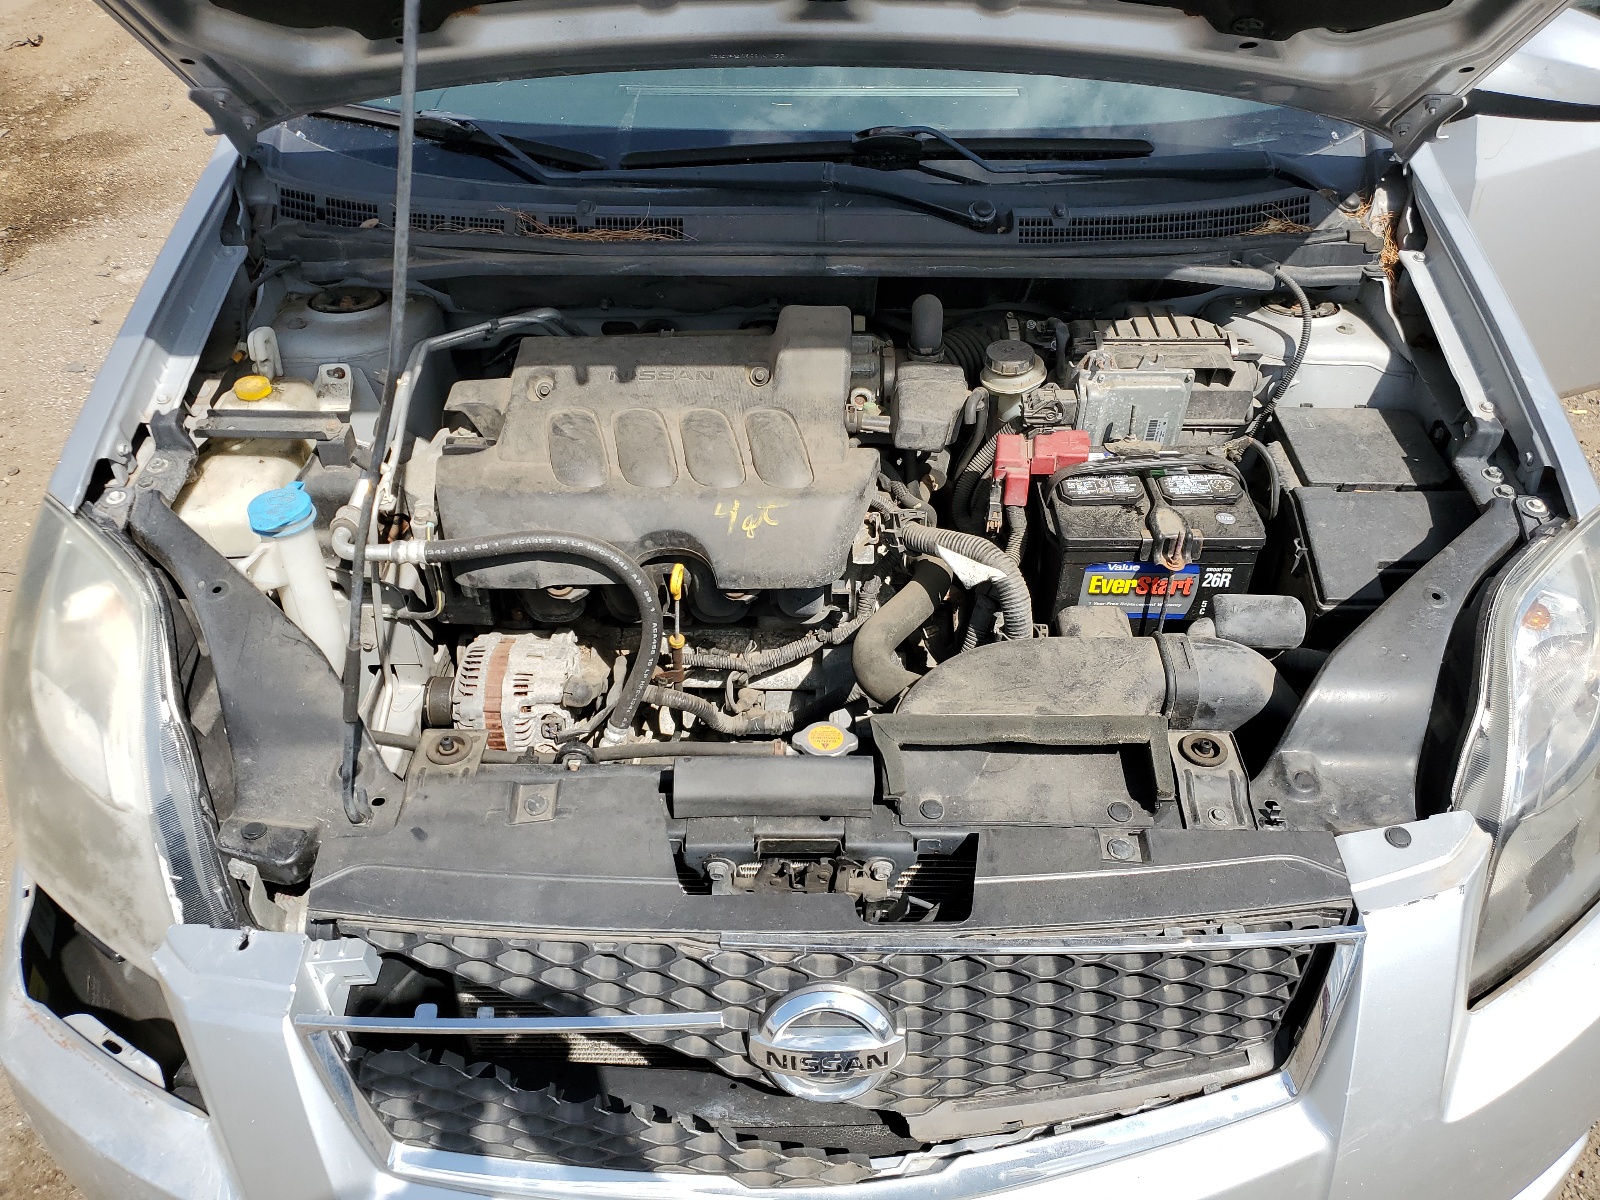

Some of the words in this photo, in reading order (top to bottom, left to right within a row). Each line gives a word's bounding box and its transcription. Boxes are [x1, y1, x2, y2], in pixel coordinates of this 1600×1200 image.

[608, 370, 715, 381] NISSAN
[714, 499, 740, 536] 4
[1107, 563, 1140, 571] Value
[1088, 575, 1194, 596] EverStart
[1201, 572, 1232, 588] 26R
[765, 1050, 889, 1074] NISSAN
